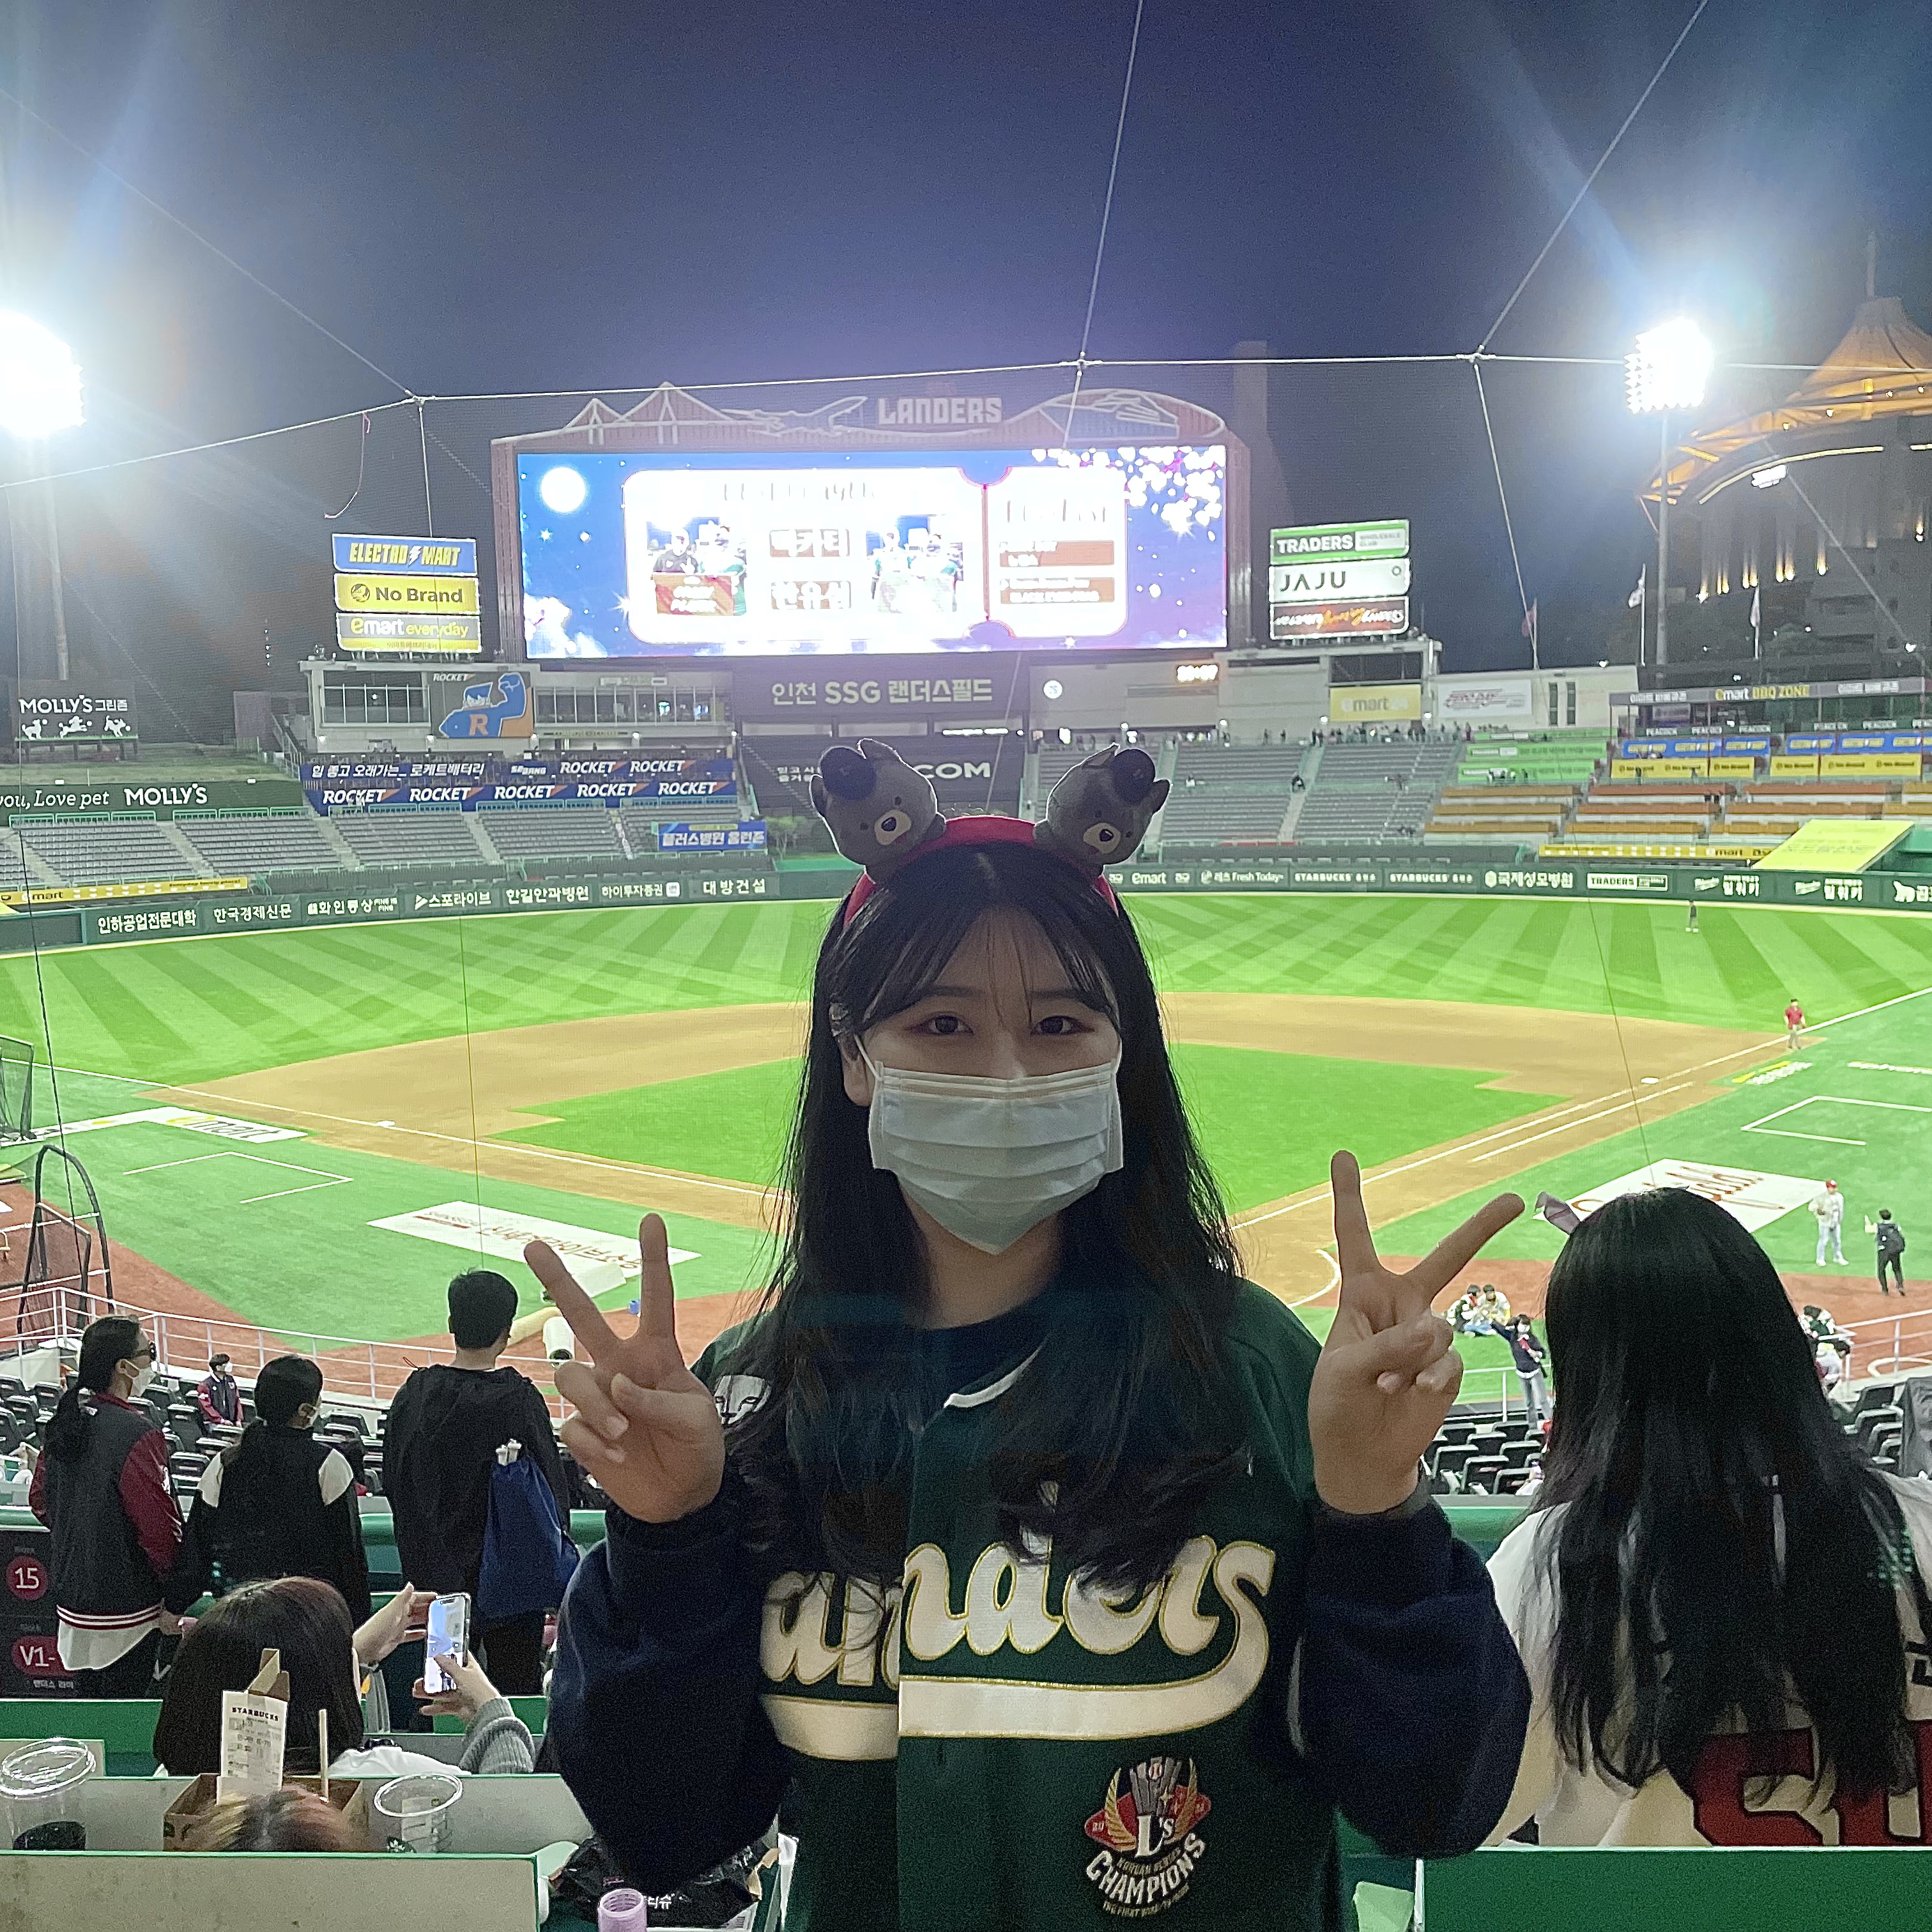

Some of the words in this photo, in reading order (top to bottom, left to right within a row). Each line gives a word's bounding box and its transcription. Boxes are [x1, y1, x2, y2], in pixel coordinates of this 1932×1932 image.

[878, 397, 1002, 425] LANDERS
[1277, 534, 1353, 553] TRADERS
[349, 542, 408, 565] ELECTRO
[420, 546, 461, 567] MART
[1280, 571, 1346, 592] JAJU
[376, 587, 402, 602] No
[407, 587, 463, 603] Brand
[350, 617, 405, 636] emart
[406, 621, 468, 638] everyday
[433, 673, 468, 682] ROCKET
[772, 682, 816, 705] 인천
[825, 680, 881, 705] SSG
[888, 678, 992, 703] 랜더스필드
[1715, 687, 1749, 701] emart
[19, 694, 93, 714] MOLLY'S
[469, 714, 488, 735] R
[410, 763, 485, 777] 로케트배터리
[560, 761, 617, 774] ROCKET
[631, 760, 686, 773] ROCKET
[124, 783, 208, 806] MOLLY'S
[409, 787, 471, 802] ROCKET
[493, 785, 556, 801] ROCKET
[577, 783, 637, 798] ROCKET
[658, 781, 717, 796] ROCKET
[33, 790, 77, 807] Love
[79, 790, 111, 810] pet
[323, 789, 387, 805] ROCKET
[1131, 872, 1167, 884] emart
[1232, 872, 1254, 881] Fresh
[1294, 873, 1352, 882] STARBUCKS
[1390, 873, 1449, 883] STARBUCKS
[1498, 871, 1573, 888] 국제성모병원
[1591, 877, 1634, 886] TRADERS
[601, 884, 663, 899] 하이투자증권
[703, 878, 766, 896] 대방건설
[429, 891, 491, 907] 스포라이브
[505, 886, 589, 905] 한길안과병원
[213, 903, 292, 923] 한국경제신문
[98, 910, 197, 935] 인하공업전문대학
[14, 1566, 40, 1590] 15
[762, 1535, 1276, 1687] anders
[232, 1706, 279, 1722] STARBUCKS
[1086, 1832, 1206, 1905] CHAMPIONS
